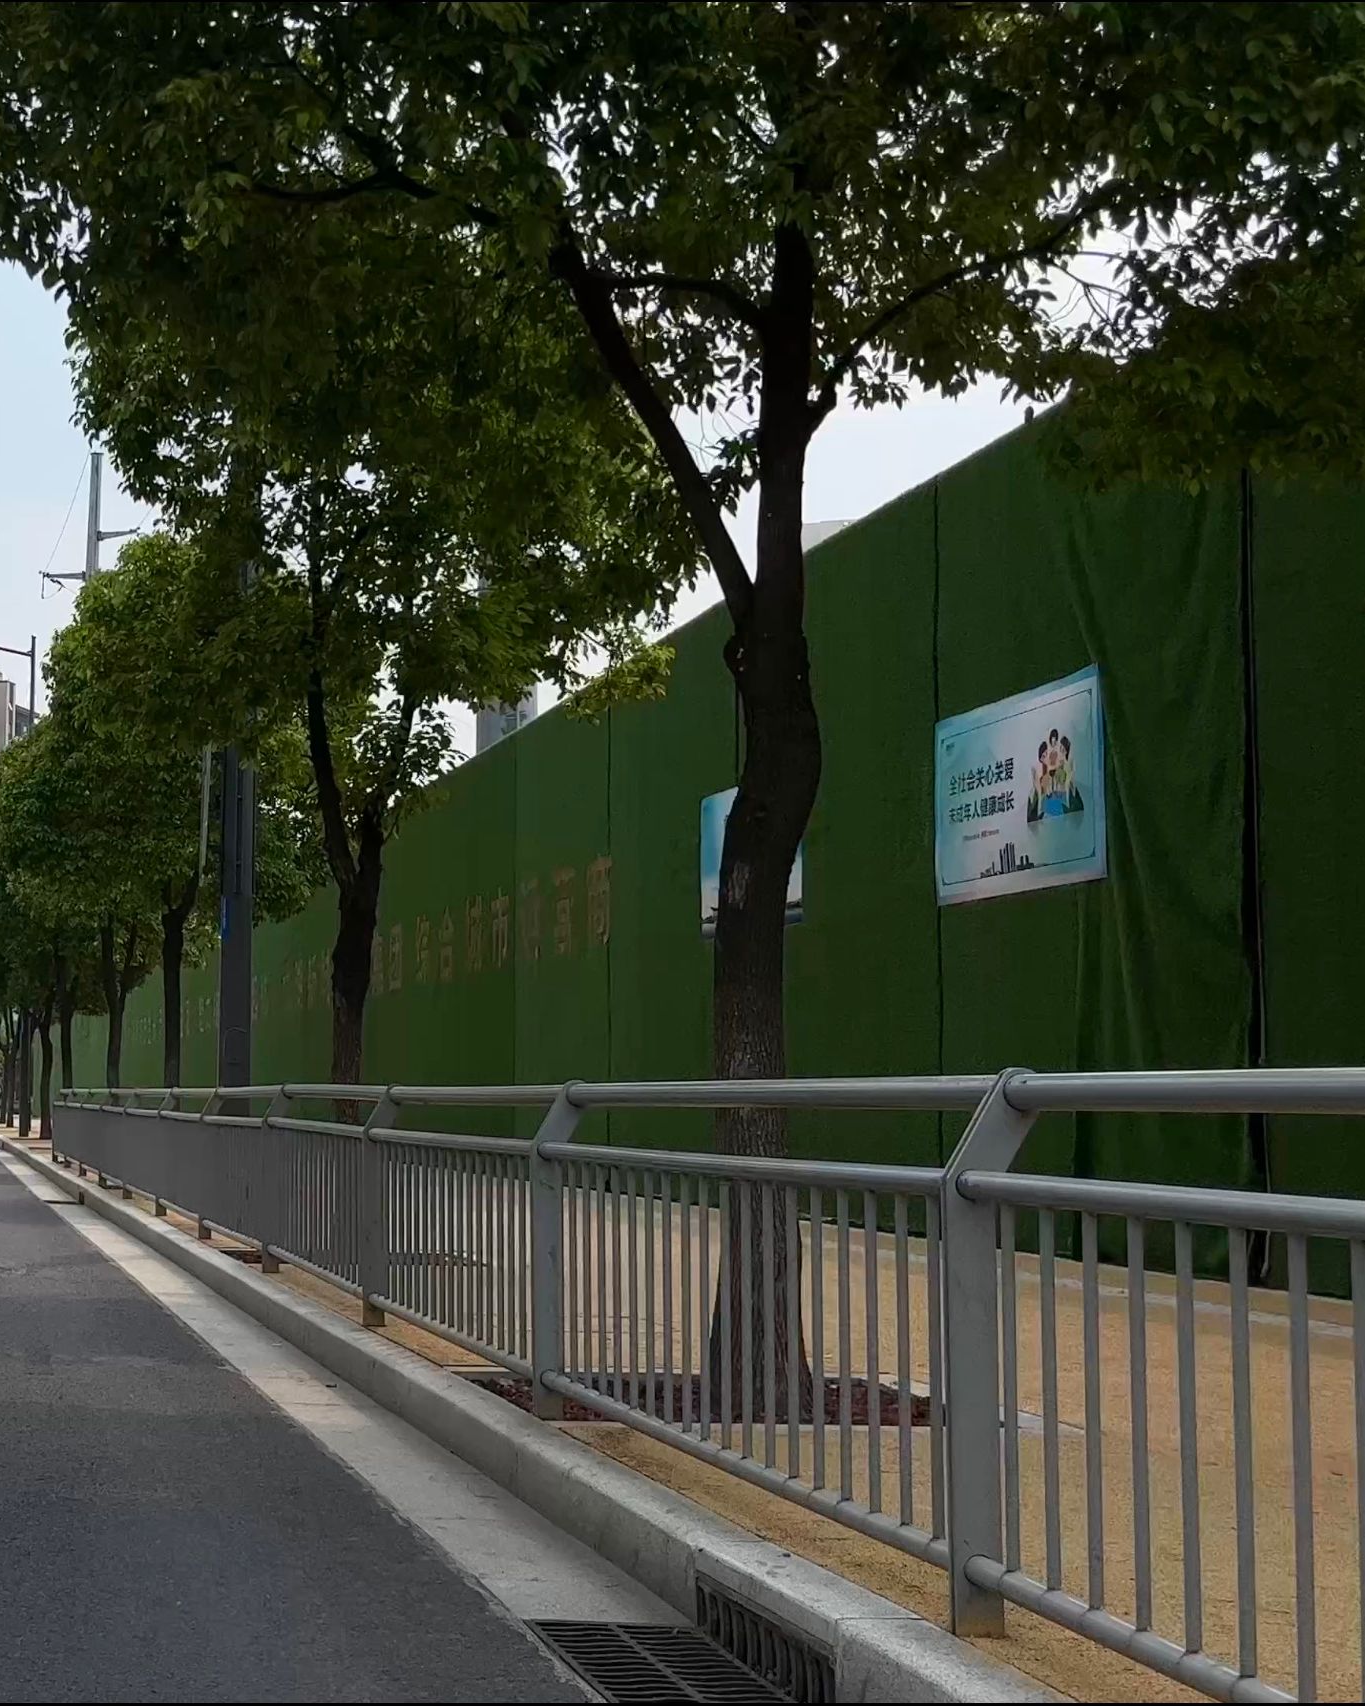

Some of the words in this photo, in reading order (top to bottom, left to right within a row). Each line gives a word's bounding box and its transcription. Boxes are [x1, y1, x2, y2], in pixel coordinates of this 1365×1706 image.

[948, 757, 1014, 797] 全社会关心关爱
[948, 790, 1015, 825] 未成年人健康成长
